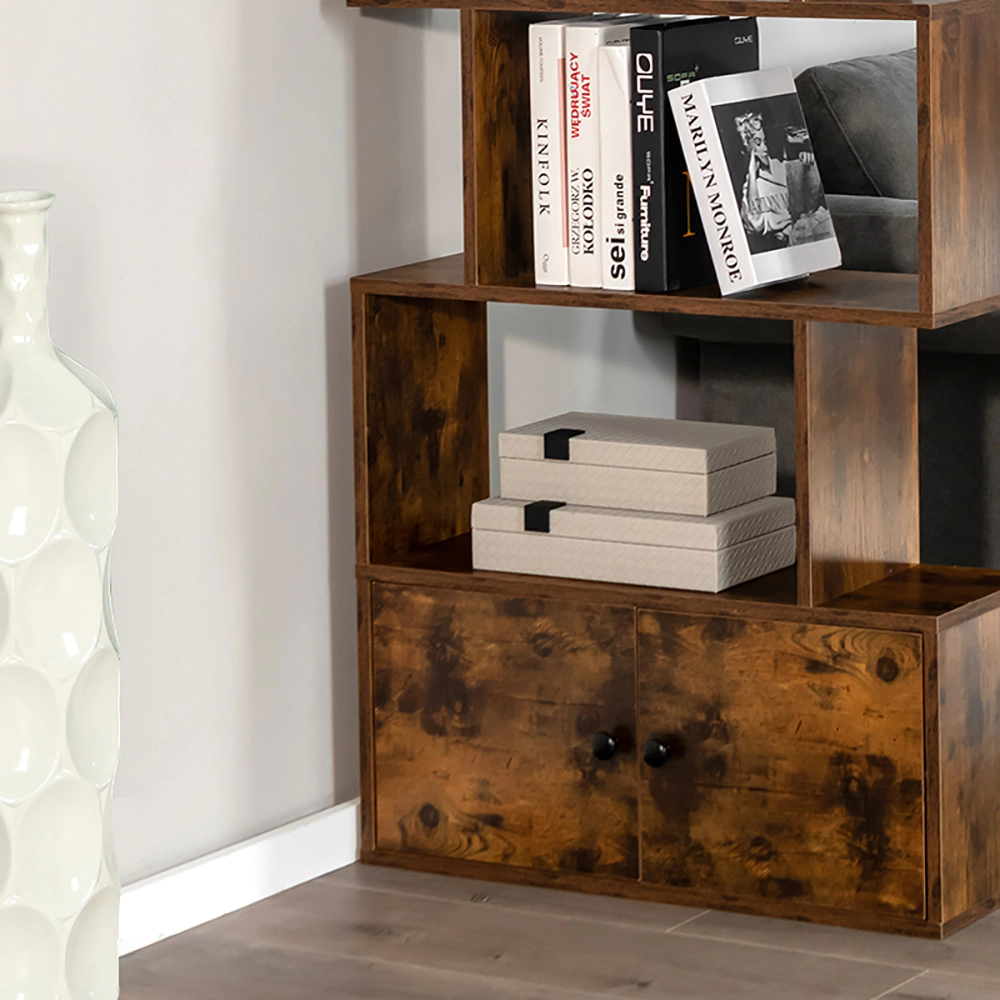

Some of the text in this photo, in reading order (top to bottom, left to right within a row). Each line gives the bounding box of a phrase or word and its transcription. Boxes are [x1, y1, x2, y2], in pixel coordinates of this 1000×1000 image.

[569, 52, 581, 139] WĘDRUJĄCY
[580, 74, 592, 118] ŚWIAT
[636, 53, 654, 133] OUYE
[536, 118, 551, 215] KINFOLK
[680, 92, 718, 189] MARILYN
[708, 192, 743, 284] MONROE
[570, 185, 581, 255] GRZEGORZ
[581, 167, 595, 255] KOŁODKO
[605, 173, 628, 280] sei si grande
[639, 184, 652, 262] Furniture
